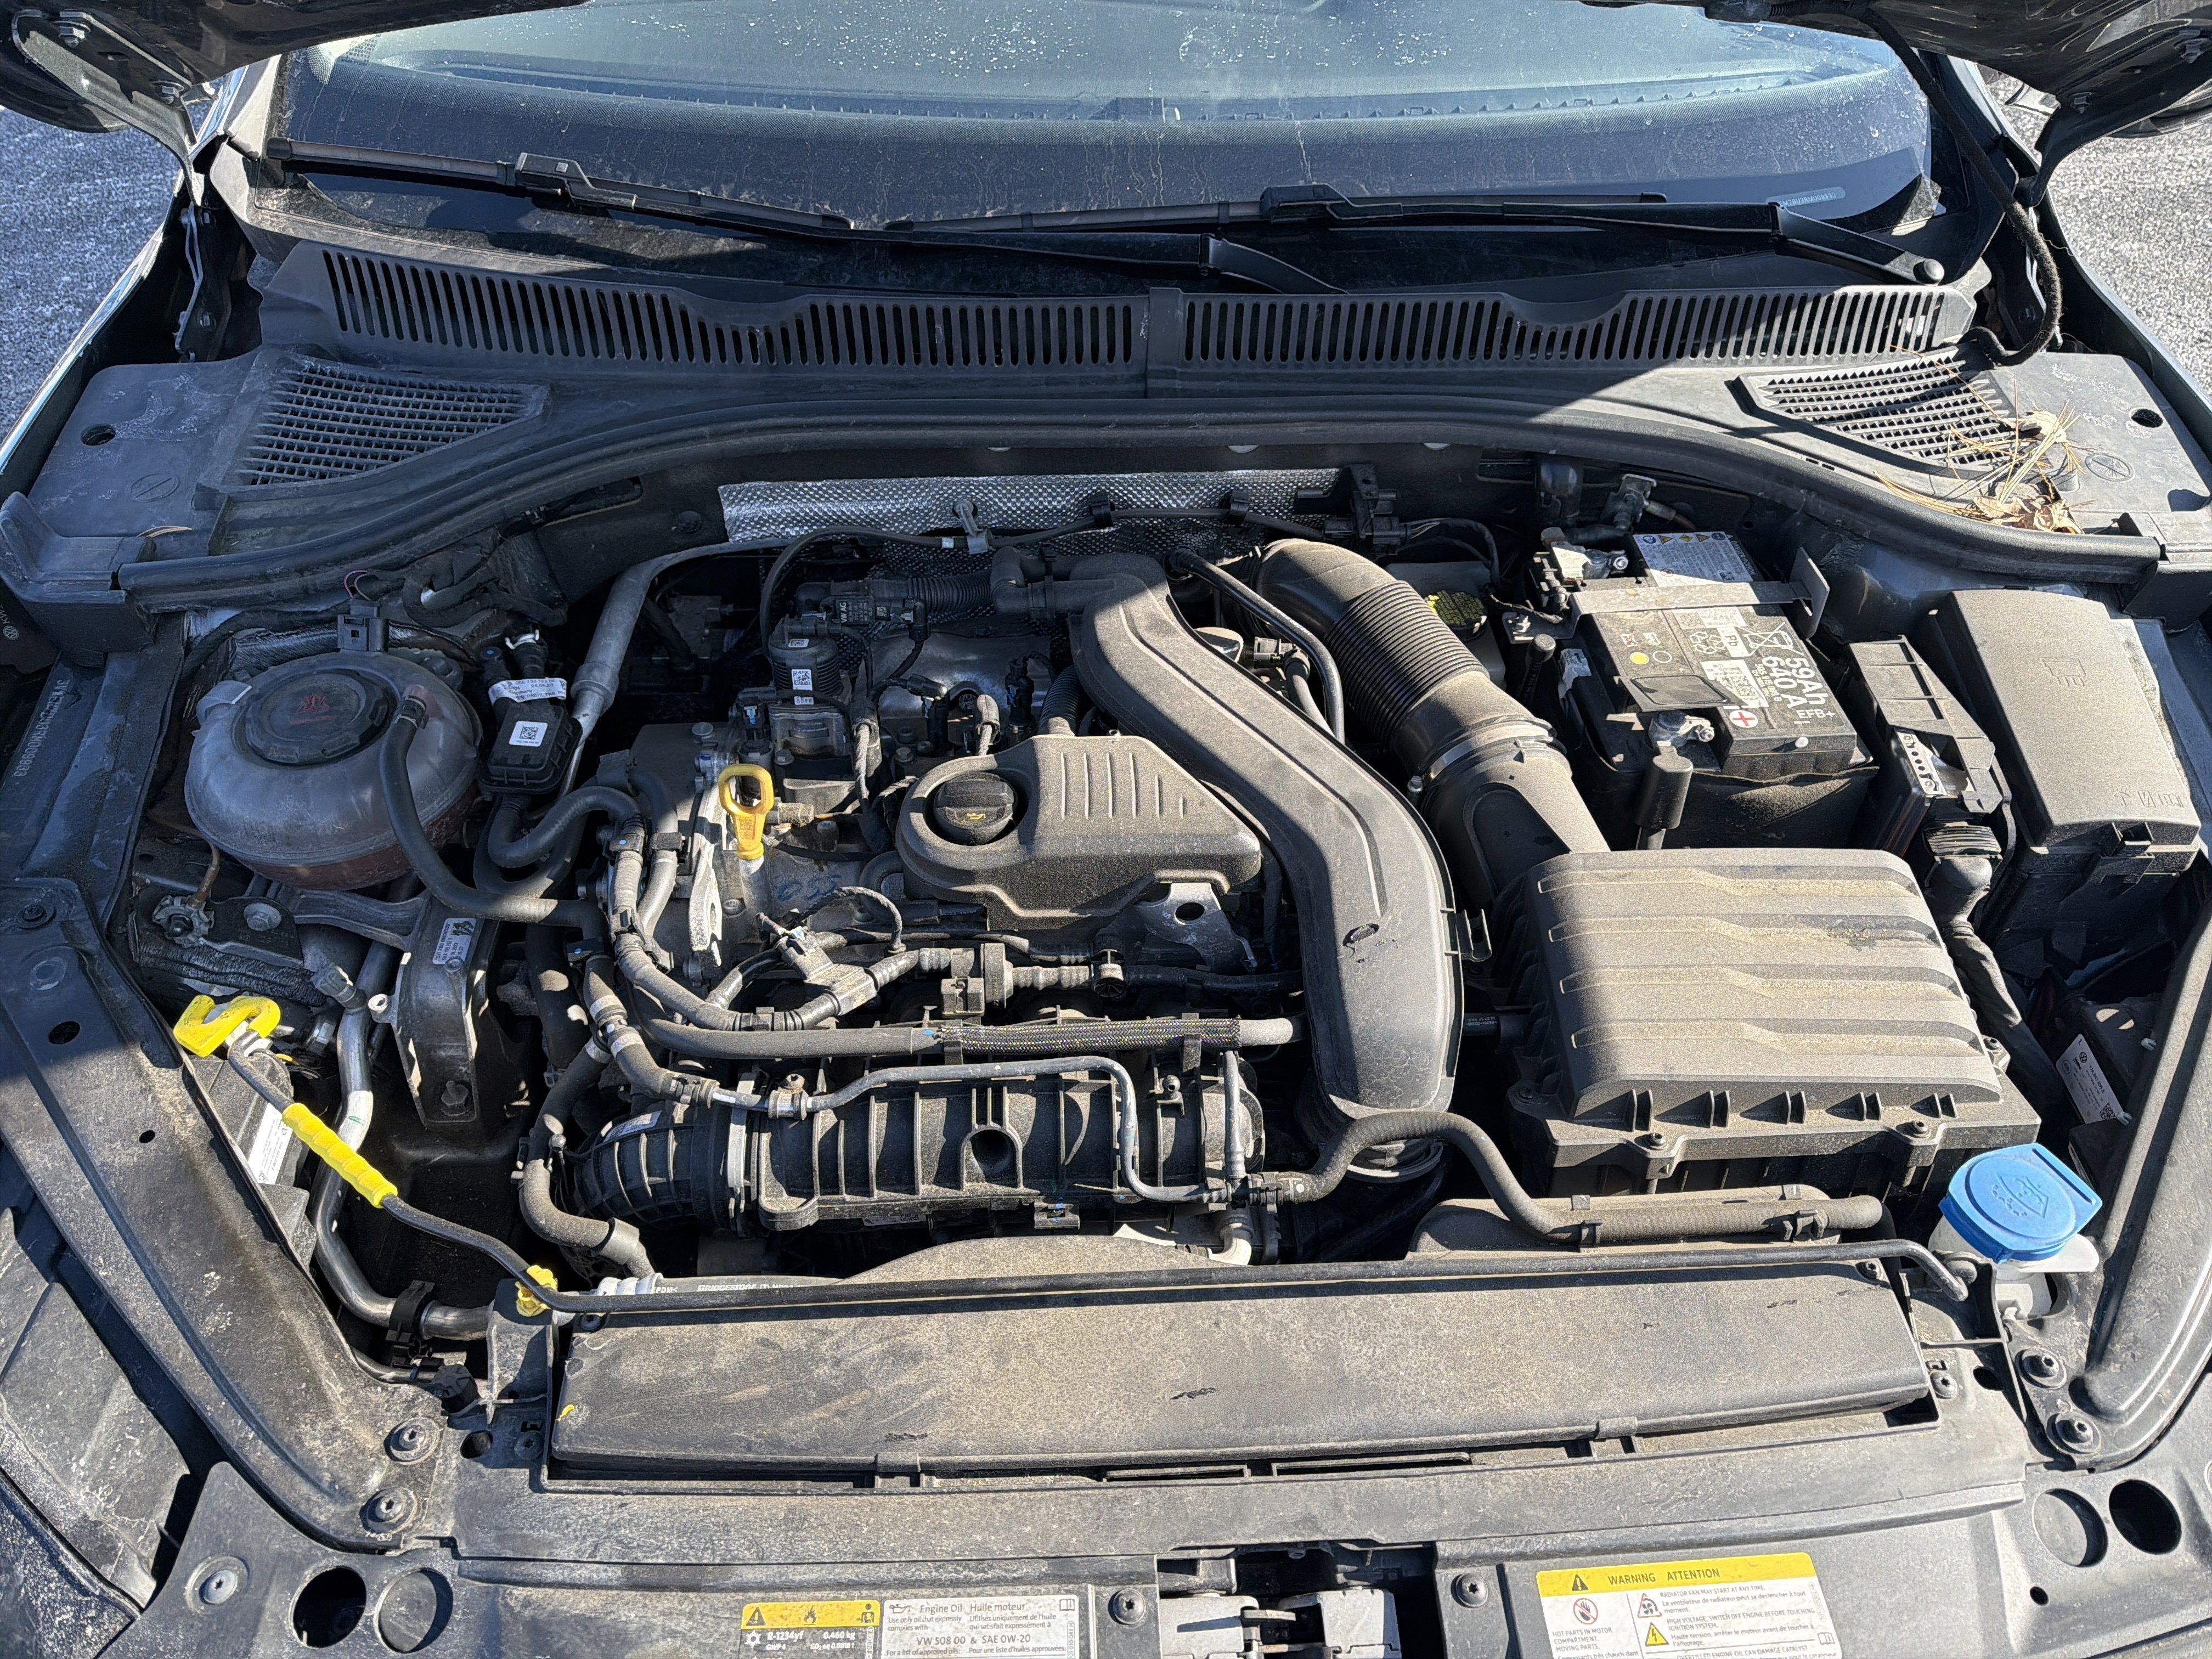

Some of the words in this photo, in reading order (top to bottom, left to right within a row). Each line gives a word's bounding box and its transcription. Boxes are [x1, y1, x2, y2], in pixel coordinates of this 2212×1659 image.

[839, 602, 847, 611] AG
[840, 613, 848, 623] VW
[1725, 635, 1739, 647] Pb
[1762, 656, 1798, 689] 640
[1781, 693, 1808, 708] A
[1785, 657, 1829, 705] 59Ah
[1796, 709, 1836, 719] EFB+
[1607, 1573, 1656, 1585] WARNING
[1667, 1568, 1720, 1581] ATTENTION
[920, 1604, 948, 1615] Engine
[950, 1603, 962, 1612] Oil
[970, 1602, 992, 1611] Huile
[994, 1602, 1025, 1611] moteur
[935, 1615, 962, 1623] expressly
[992, 1614, 1029, 1622] uniquement
[1005, 1622, 1046, 1630] expressément
[767, 1630, 804, 1642] R-1234yf
[822, 1631, 845, 1639] 0.460
[846, 1631, 855, 1641] kg
[916, 1637, 933, 1645] VW
[935, 1636, 951, 1645] 508
[953, 1636, 966, 1645] 00
[981, 1635, 998, 1644] SAE
[1001, 1634, 1031, 1643] 0W-20
[918, 1647, 948, 1656] approved
